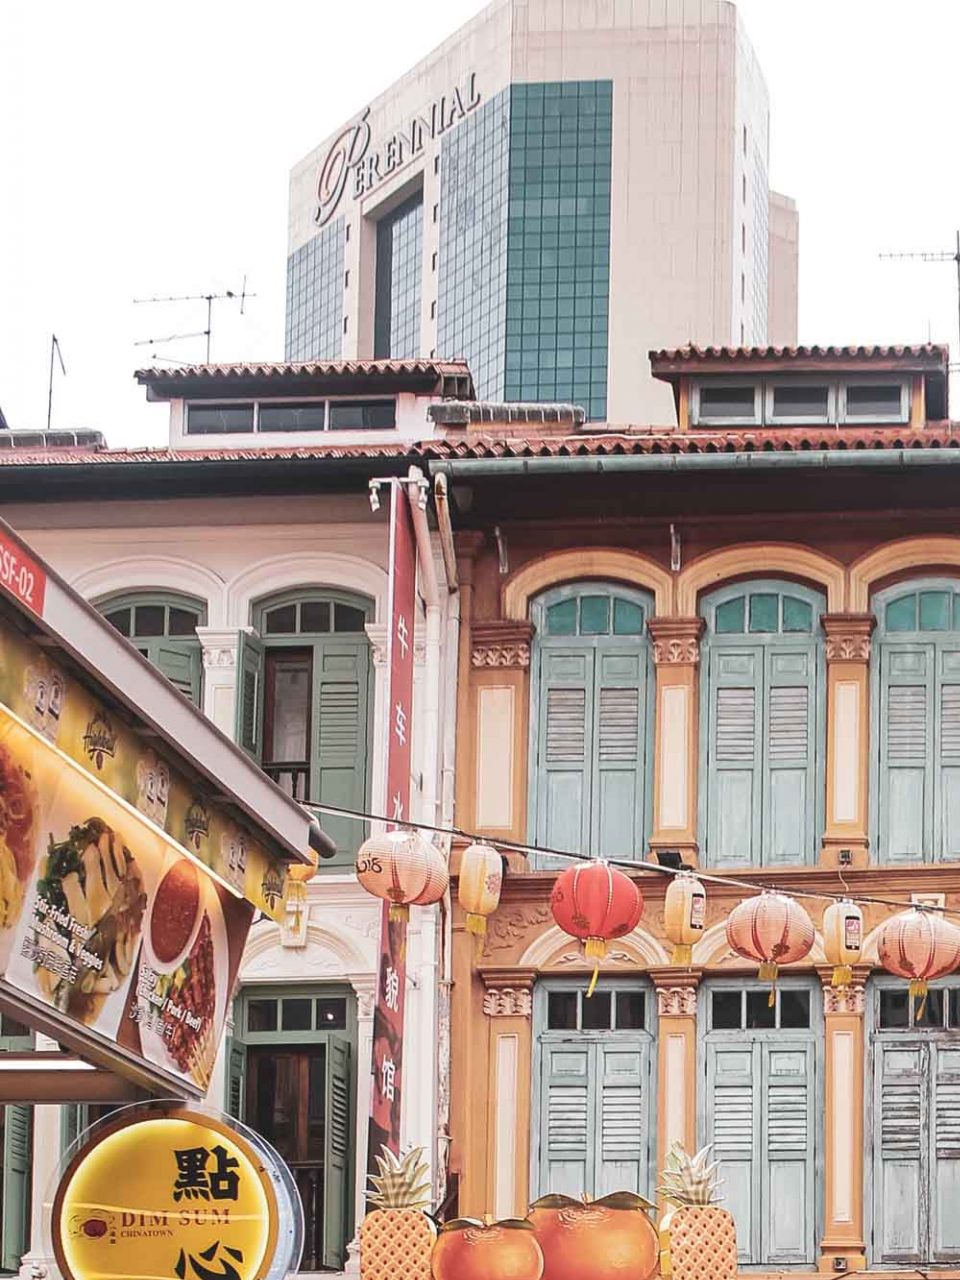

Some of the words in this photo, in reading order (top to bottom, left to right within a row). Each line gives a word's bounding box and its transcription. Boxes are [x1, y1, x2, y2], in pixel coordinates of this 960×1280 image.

[122, 1210, 168, 1228] DIM
[179, 1208, 231, 1226] SUM
[121, 1230, 174, 1238] CHINATOWN
